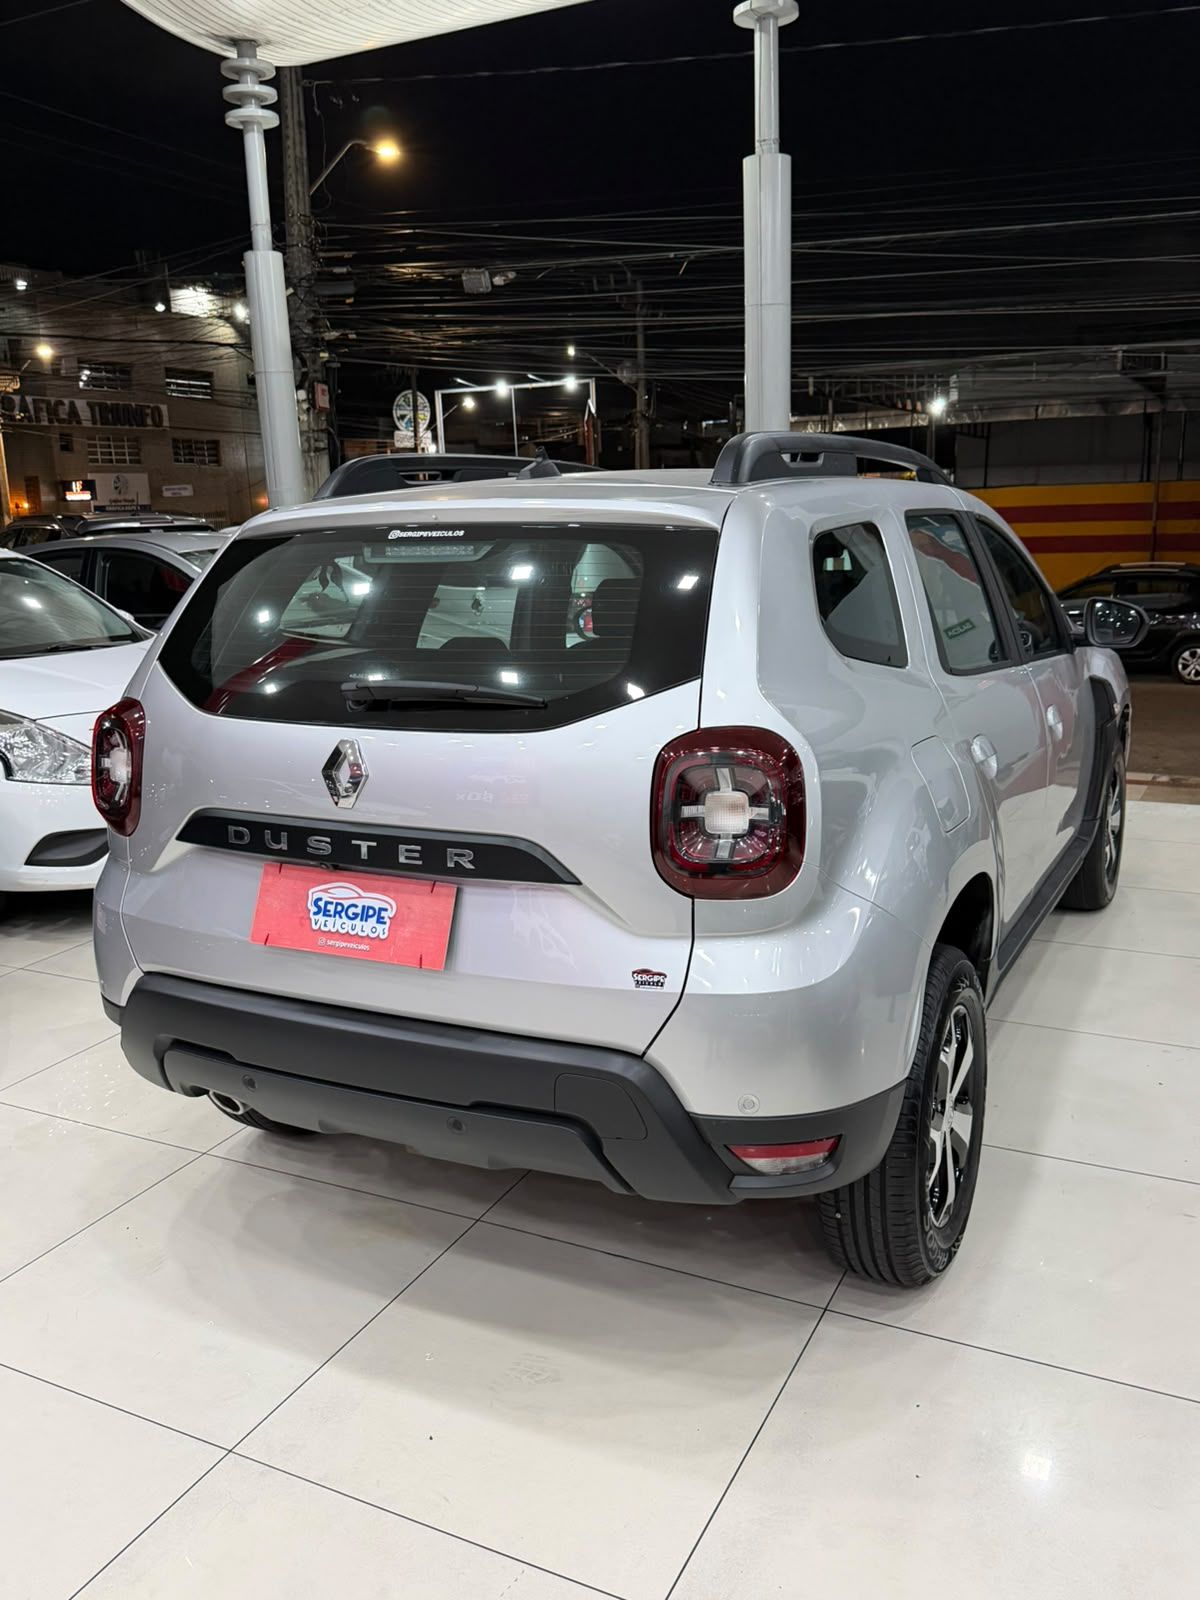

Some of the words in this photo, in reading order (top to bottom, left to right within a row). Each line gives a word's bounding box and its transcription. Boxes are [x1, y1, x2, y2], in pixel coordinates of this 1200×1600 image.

[87, 401, 164, 427] TRIUNFO
[227, 824, 476, 869] DUSTER
[312, 896, 389, 925] SERGIPE
